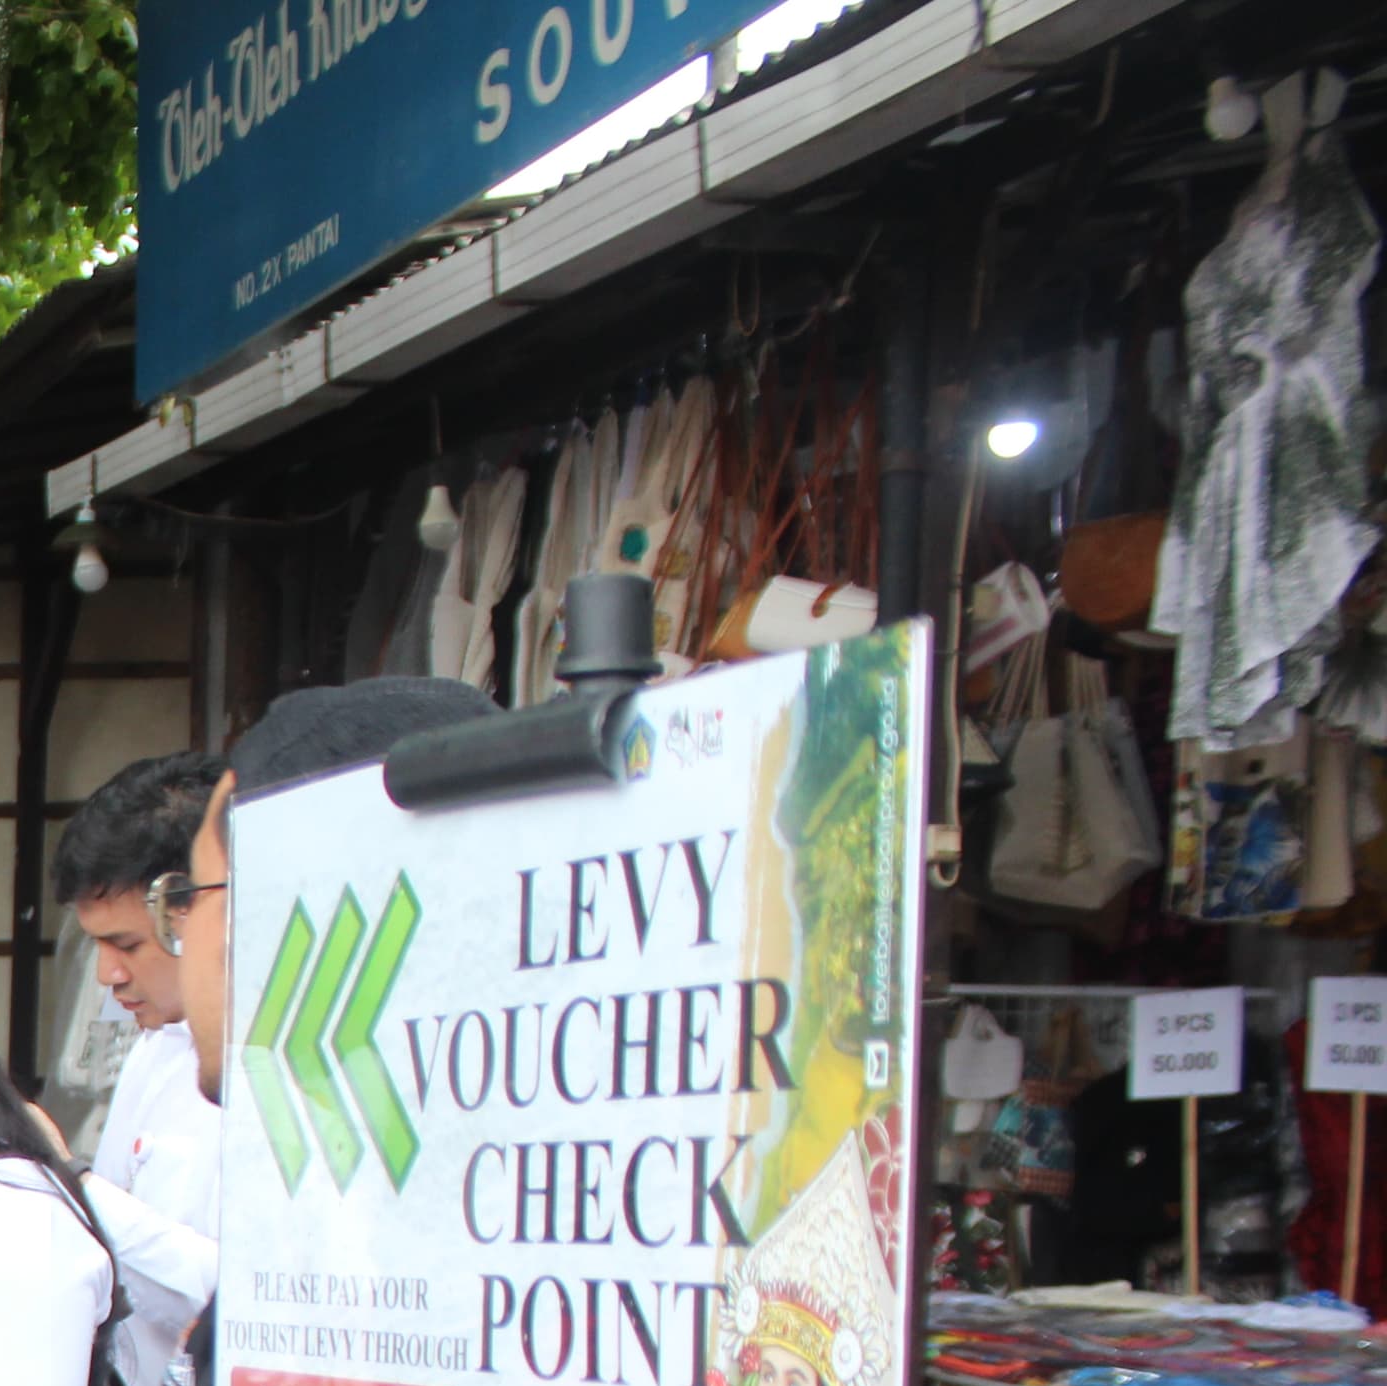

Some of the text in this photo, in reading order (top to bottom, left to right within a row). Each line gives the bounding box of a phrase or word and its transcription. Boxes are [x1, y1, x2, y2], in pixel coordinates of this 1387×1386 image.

[159, 2, 302, 192] Oleh-Oleh
[476, 0, 688, 143] SOU
[287, 212, 340, 277] PANTAI
[514, 829, 738, 972] LEVY
[404, 977, 801, 1114] VOUCHER
[1152, 1051, 1219, 1073] 50.000
[1175, 1012, 1216, 1033] PCS
[462, 1133, 755, 1249] CHECK
[254, 1271, 429, 1311] PLEASE PAY YOUR
[224, 1319, 469, 1372] TOURIST LEVY THROUGH
